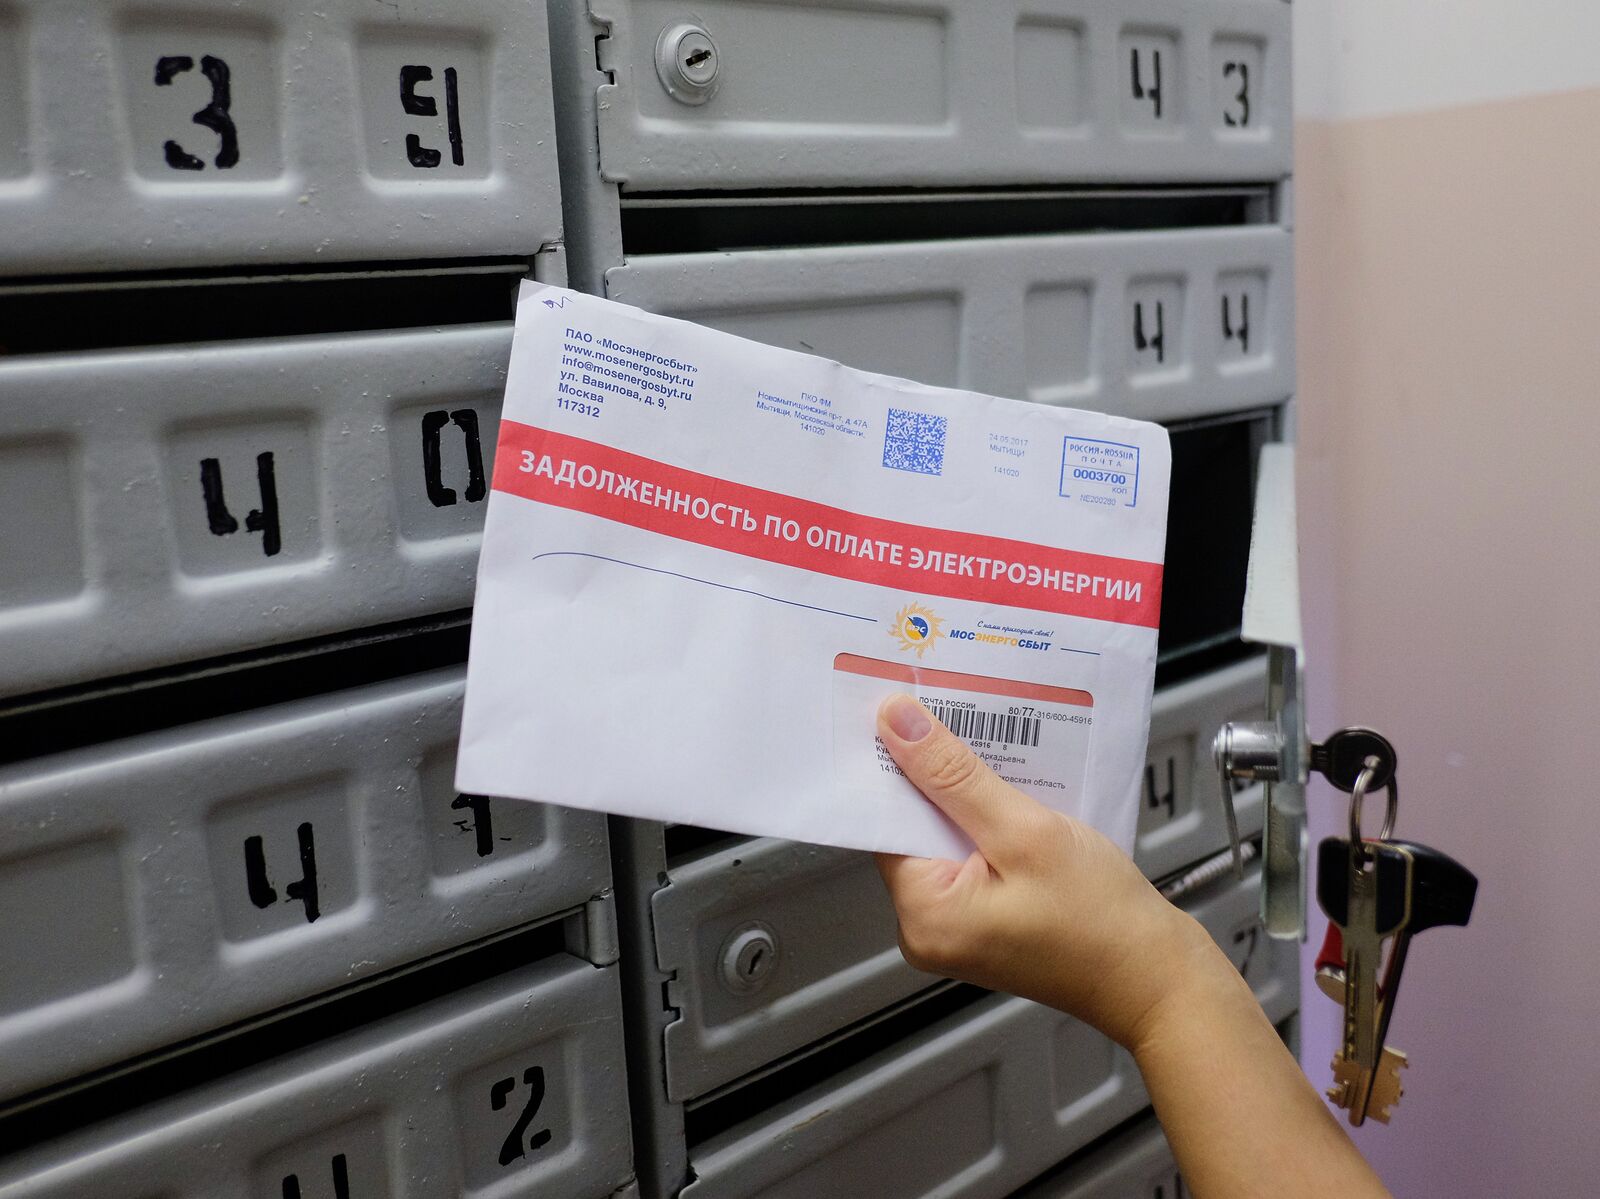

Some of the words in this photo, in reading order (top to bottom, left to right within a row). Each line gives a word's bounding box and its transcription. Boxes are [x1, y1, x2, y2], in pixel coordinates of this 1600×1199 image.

[565, 328, 593, 344] ПАО
[596, 338, 698, 374] «Мосэнергосбыт»
[564, 343, 694, 388] www.mosenergosbyt.ru
[562, 355, 692, 401] info@mosenergosbyt.ru
[558, 382, 605, 404] Москва
[560, 370, 579, 383] ул.
[582, 374, 643, 403] Вавилова,
[644, 395, 655, 407] д.
[657, 398, 668, 411] 9,
[801, 392, 818, 403] ПКО
[556, 397, 601, 418] 117312
[757, 390, 828, 417] Новомытищинский
[853, 419, 869, 429] 47А
[800, 423, 826, 437] 141020
[989, 444, 1025, 458] МЫТИЩИ
[993, 466, 1020, 478] 141020
[1073, 468, 1127, 486] 0003700
[519, 450, 758, 533] ЗАДОЛЖЕННОСТЬ
[763, 514, 801, 543] ПО
[806, 525, 903, 566] ОПЛАТЕ
[909, 547, 1142, 603] ЭЛЕКТРОЭНЕРГИИ
[949, 629, 1052, 652] МОСЭНЕРГОСБЫТ
[918, 696, 945, 707] ПОЧТА
[945, 699, 977, 711] РОССИИ
[979, 751, 1026, 765] Аркадьевна
[1033, 778, 1066, 790] область
